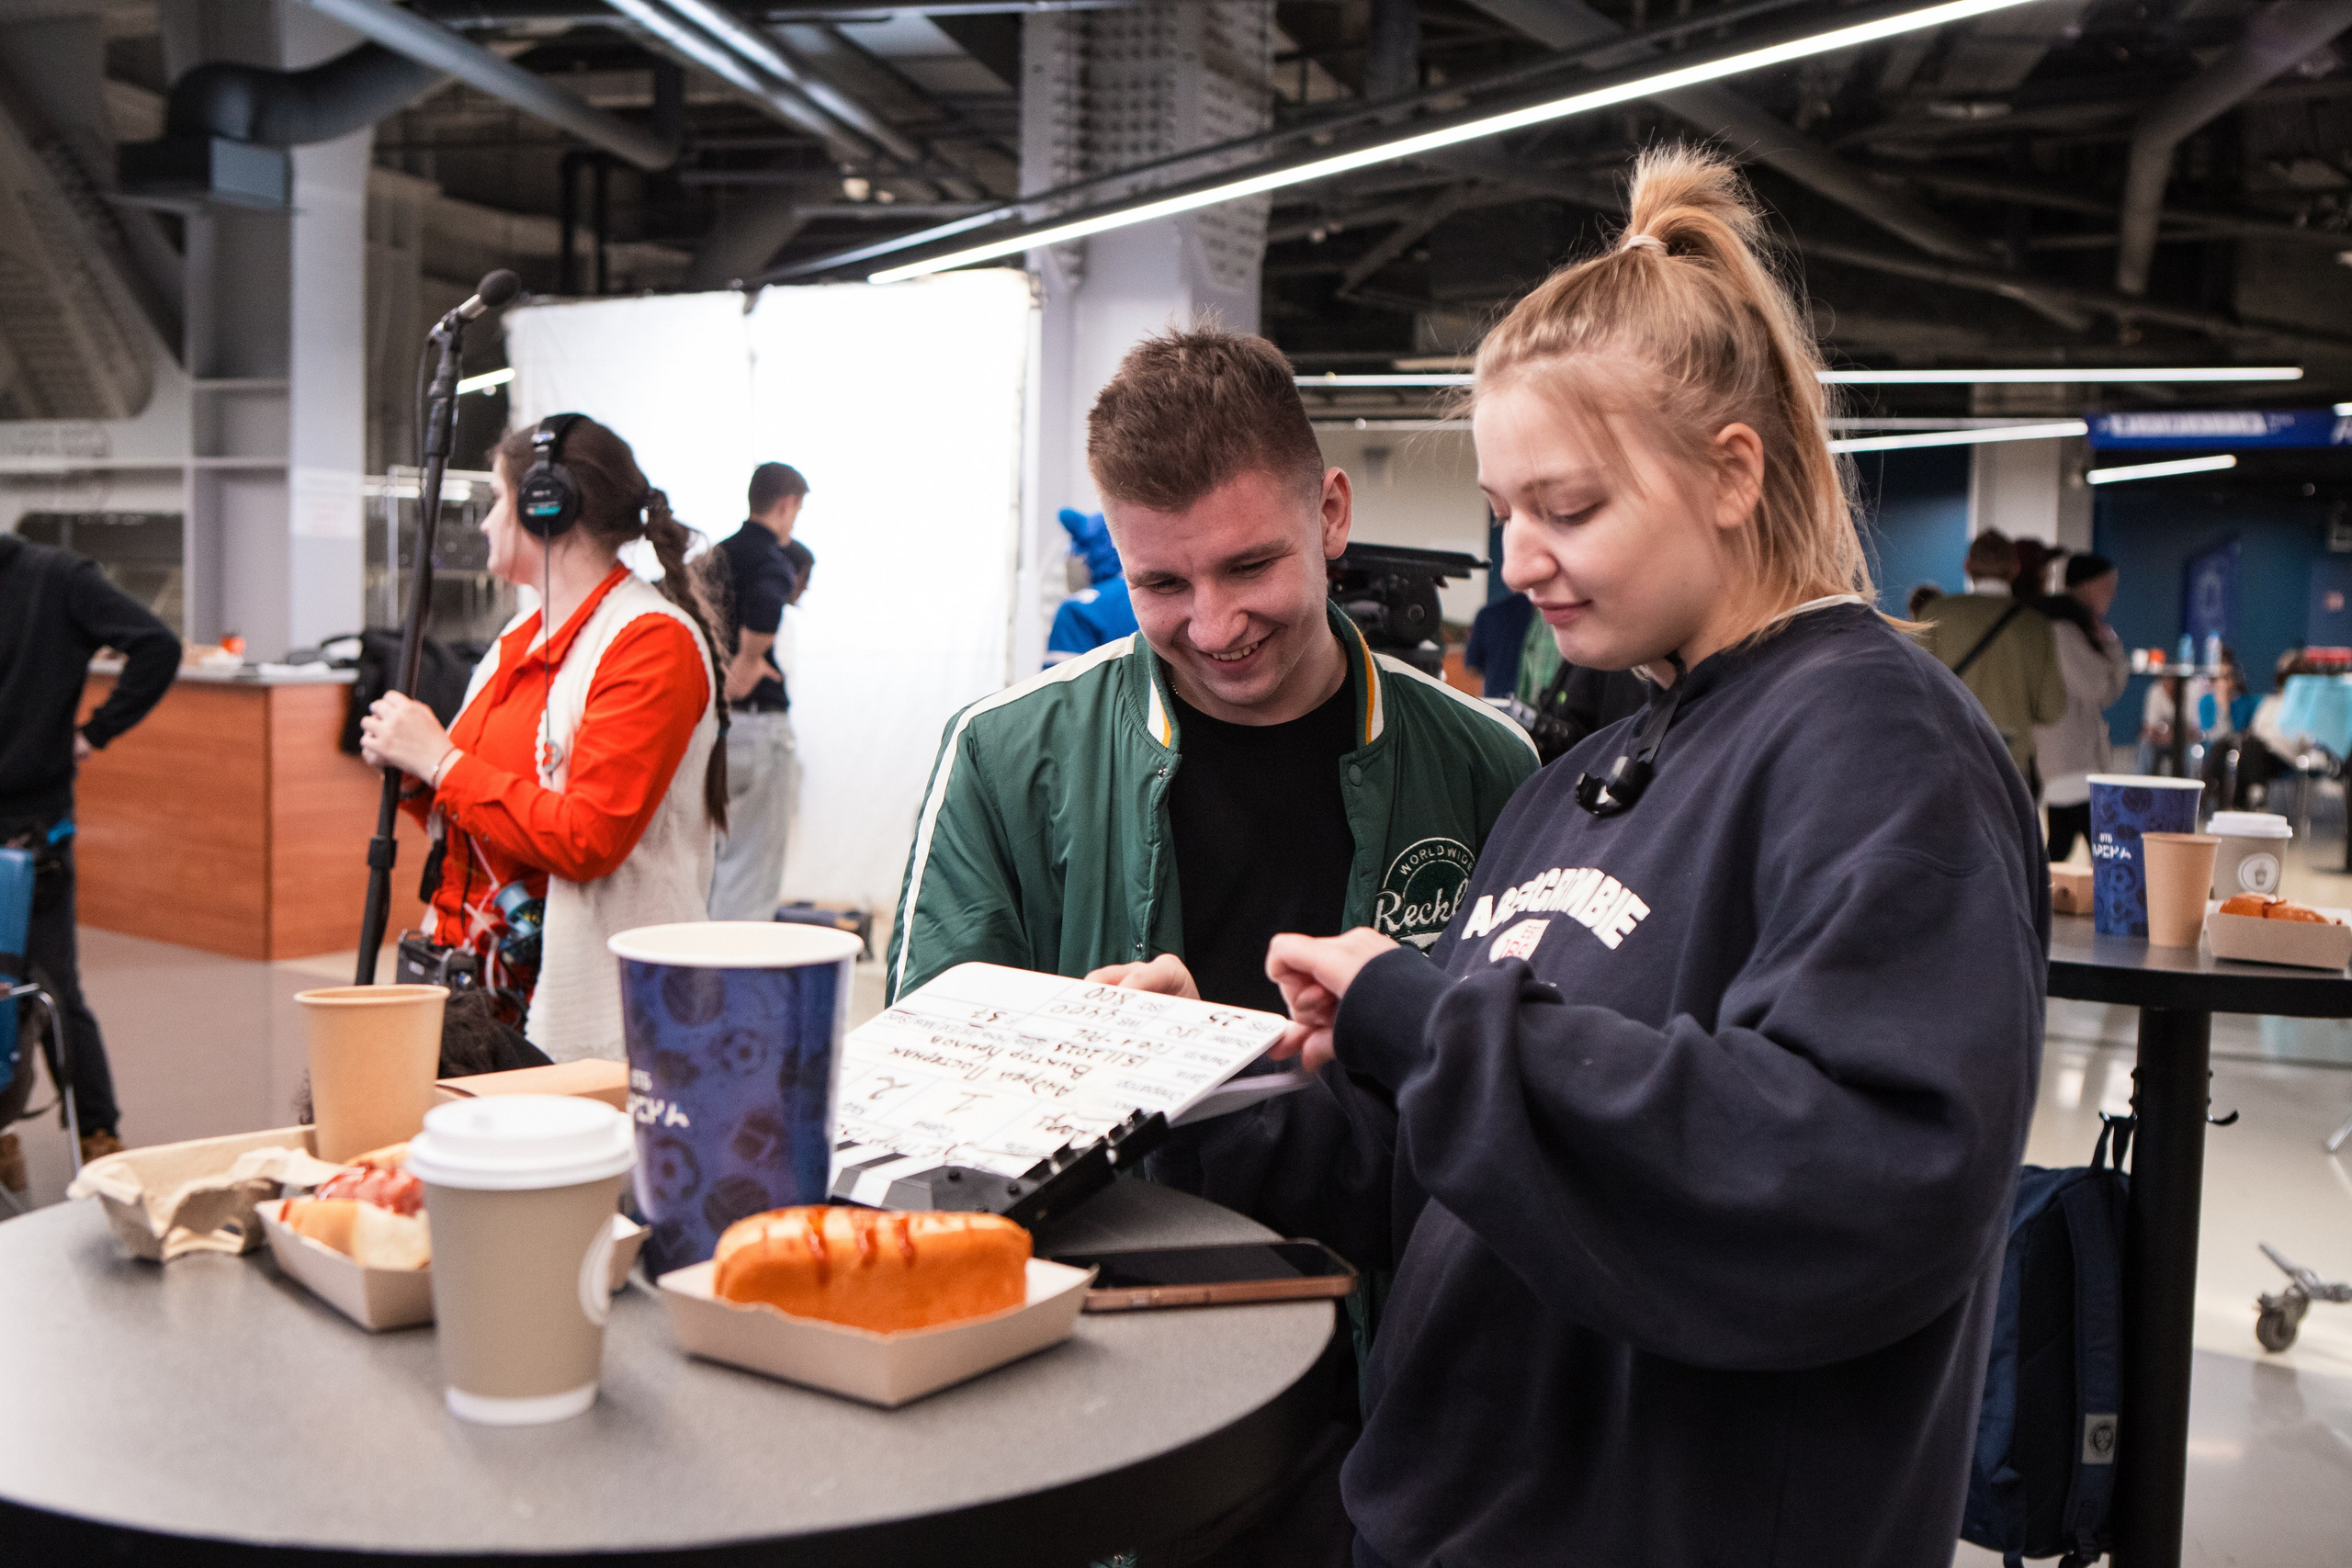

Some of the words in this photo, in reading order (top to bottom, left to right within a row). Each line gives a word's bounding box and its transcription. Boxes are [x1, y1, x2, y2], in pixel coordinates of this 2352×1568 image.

[1399, 845, 1474, 875] WORLDWIDE
[1083, 987, 1137, 1007] 800
[1048, 1003, 1121, 1024] 4400
[1009, 1050, 1093, 1081] Виктор
[866, 1077, 911, 1101] 2
[944, 1092, 995, 1115] 1
